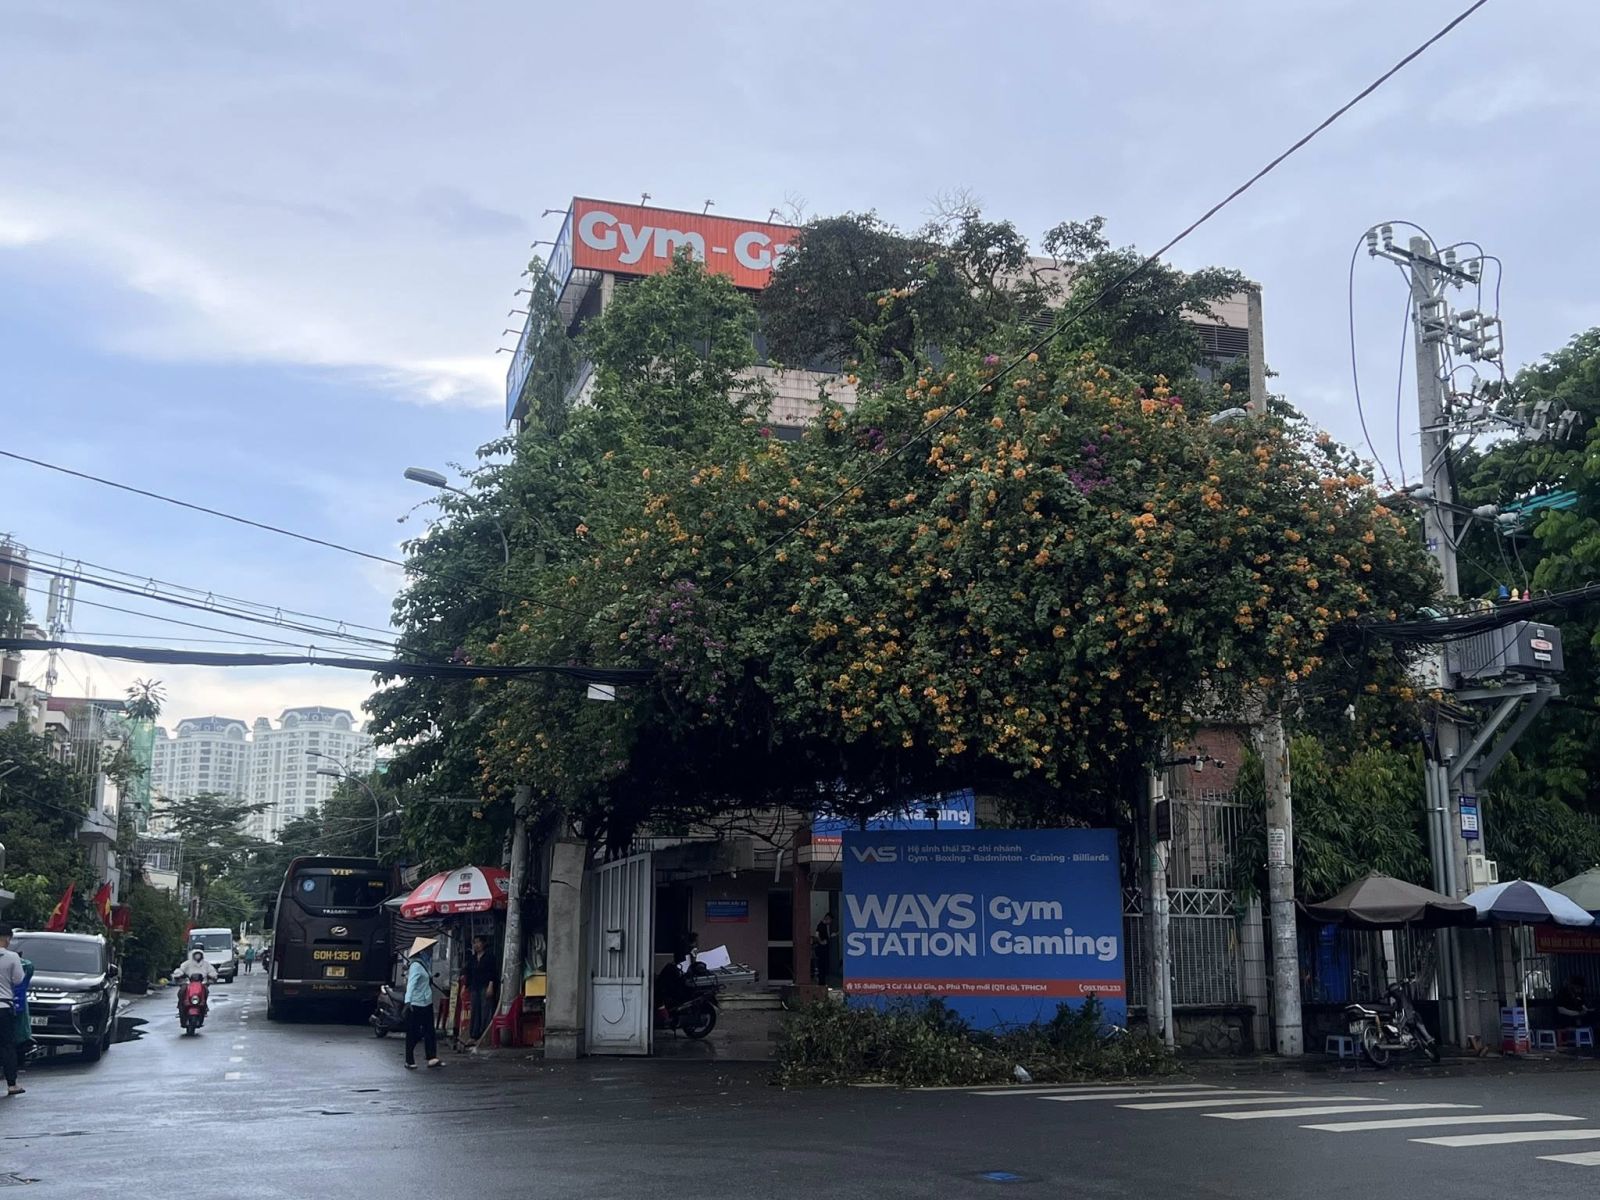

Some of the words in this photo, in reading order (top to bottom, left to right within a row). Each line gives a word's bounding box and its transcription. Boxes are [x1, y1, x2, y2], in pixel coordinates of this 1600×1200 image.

[908, 854, 928, 863] Gym
[935, 853, 966, 863] Boxing
[973, 853, 1023, 862] Badminton
[1030, 854, 1066, 864] Gaming
[1072, 853, 1109, 862] Billiards
[923, 845, 940, 854] sinh
[942, 845, 959, 854] thái
[977, 846, 990, 854] chi
[992, 845, 1022, 854] nhánh
[330, 868, 353, 876] VIP
[845, 893, 976, 929] WAYS
[989, 896, 1063, 925] Gym
[847, 932, 977, 957] STATION
[990, 928, 1118, 961] Gaming
[1020, 983, 1047, 991] TPHCM
